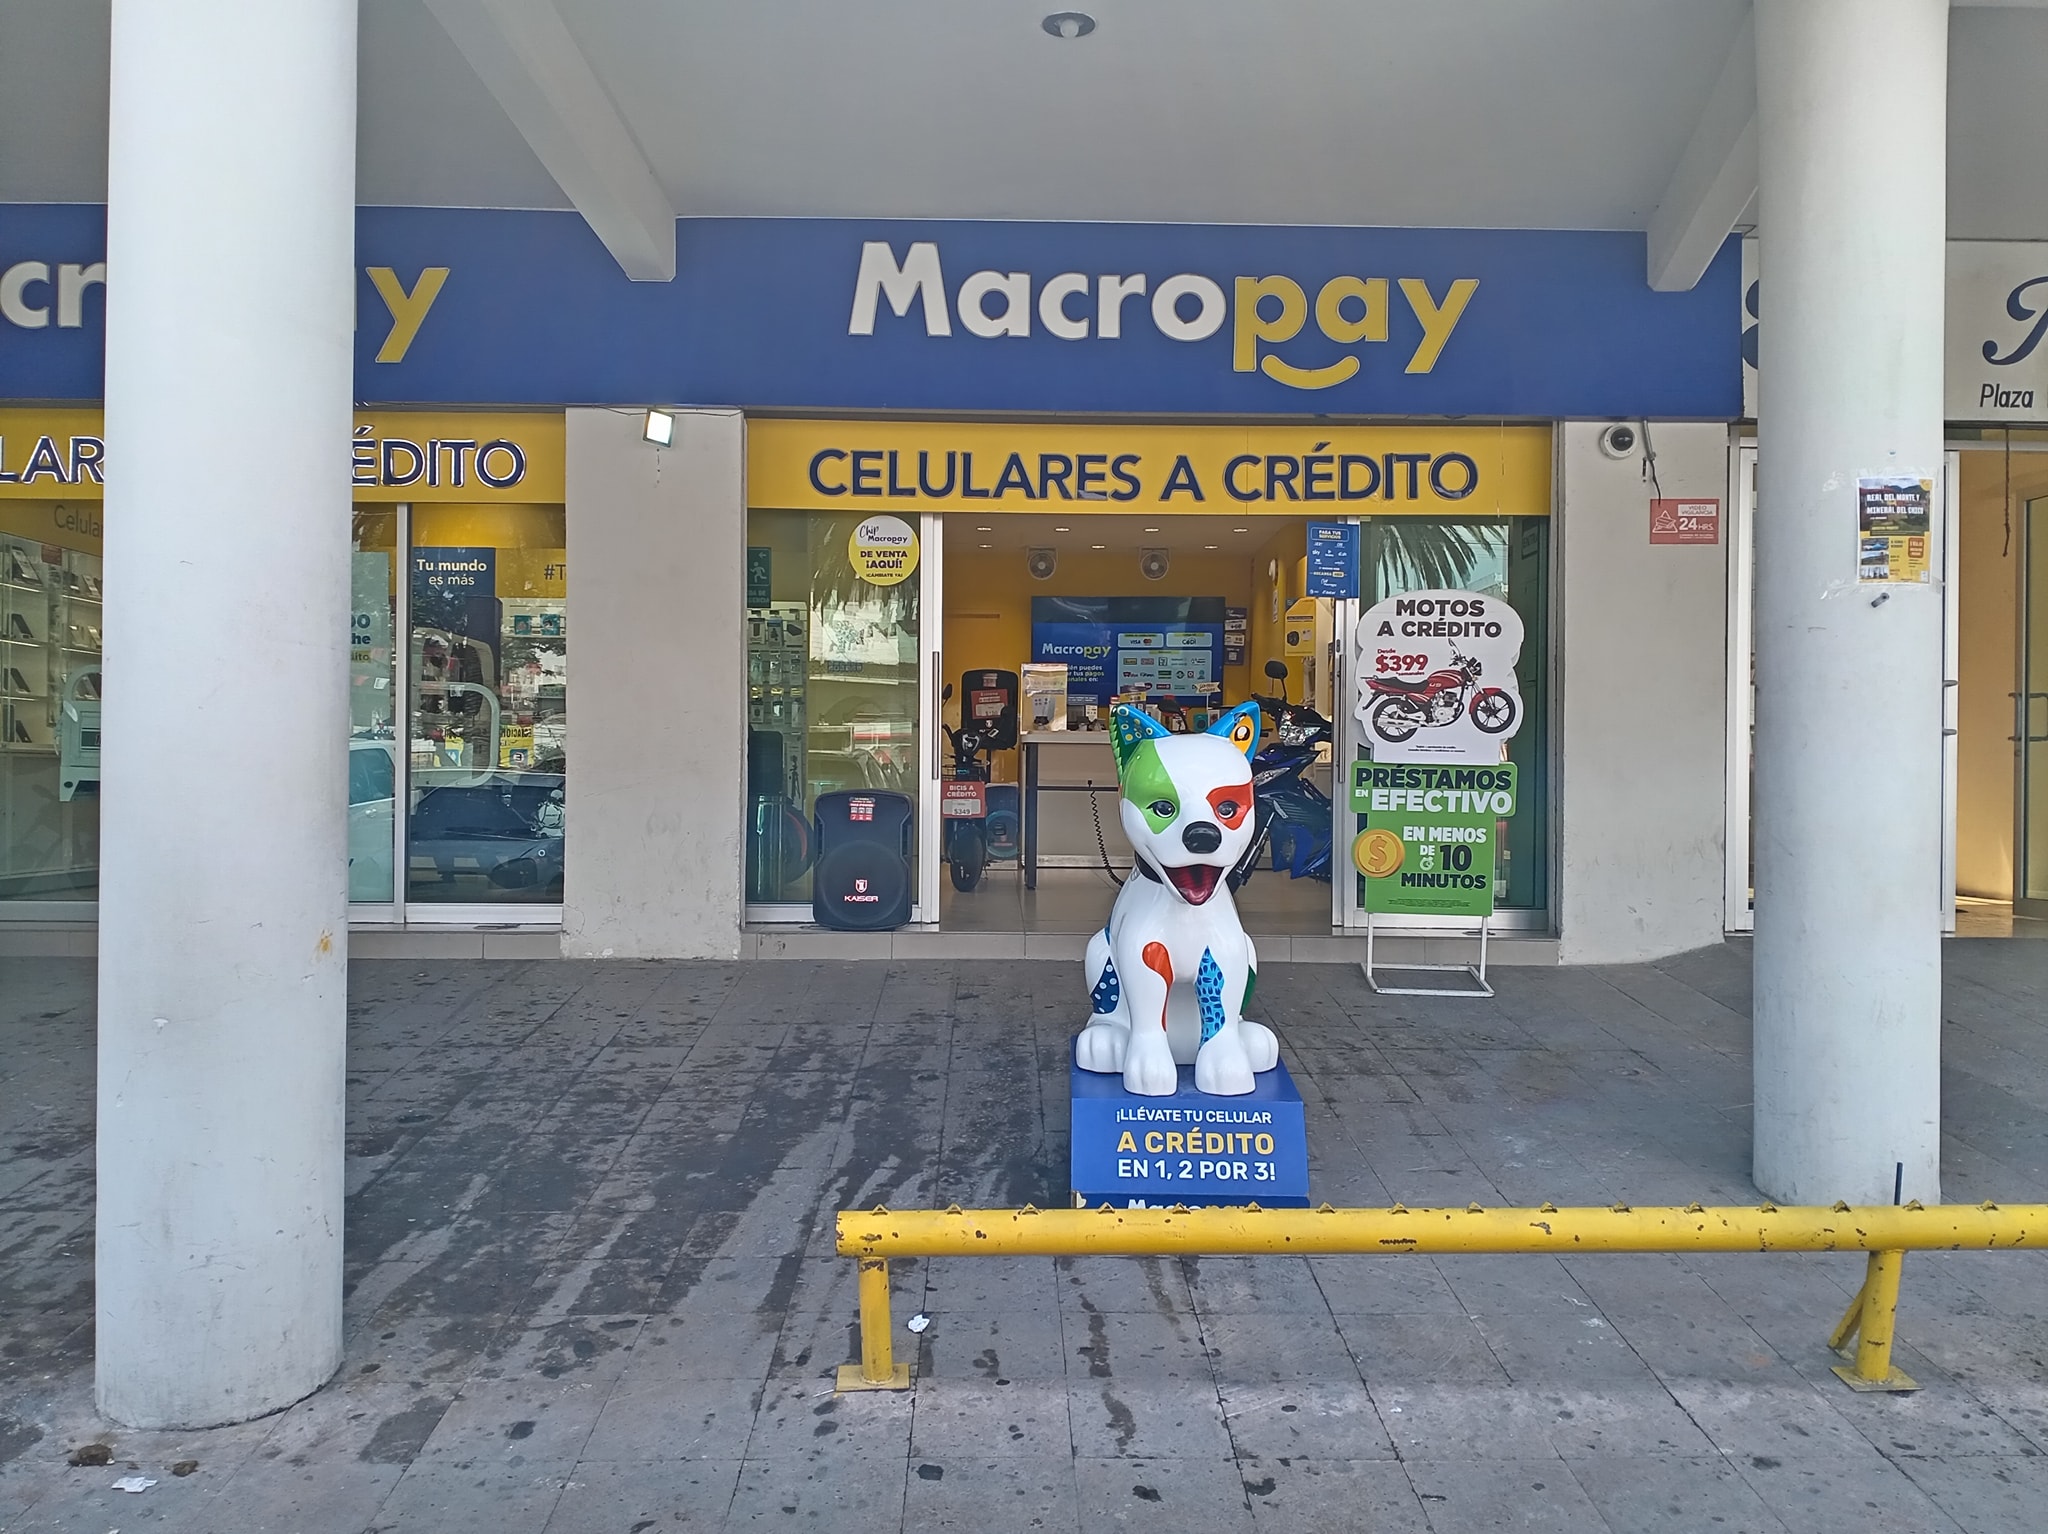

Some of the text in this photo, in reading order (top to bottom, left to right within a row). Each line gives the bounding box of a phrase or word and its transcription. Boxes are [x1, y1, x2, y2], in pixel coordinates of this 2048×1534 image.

[849, 241, 1479, 389] Macropay
[1979, 382, 2034, 408] Plaza
[808, 442, 1479, 503] CELULARES A CRÉDITO
[1679, 517, 1697, 530] 24
[868, 535, 908, 544] Macropay
[860, 550, 908, 558] DE VENTA
[416, 558, 487, 572] Tu mundo
[866, 558, 902, 569] ¡AQUÍ!
[428, 573, 475, 585] es más
[1396, 599, 1484, 617] MOTOS
[1377, 618, 1502, 638] A CRÉDITO
[1042, 642, 1111, 659] Macropay
[1079, 664, 1103, 672] puedes
[1375, 654, 1429, 673] $399
[1356, 763, 1512, 790] PRÉSTAMOS
[1355, 789, 1513, 814] EN EFECTIVO
[1403, 826, 1487, 843] EN MENOS
[1419, 845, 1473, 871] DE 10
[1401, 872, 1487, 889] MINUTOS
[1116, 1106, 1272, 1124] ¡LLÉVATE TU CELULAR
[1117, 1127, 1275, 1155] A CRÉDITO
[1118, 1159, 1276, 1181] EN 1, 2 POR 3!
